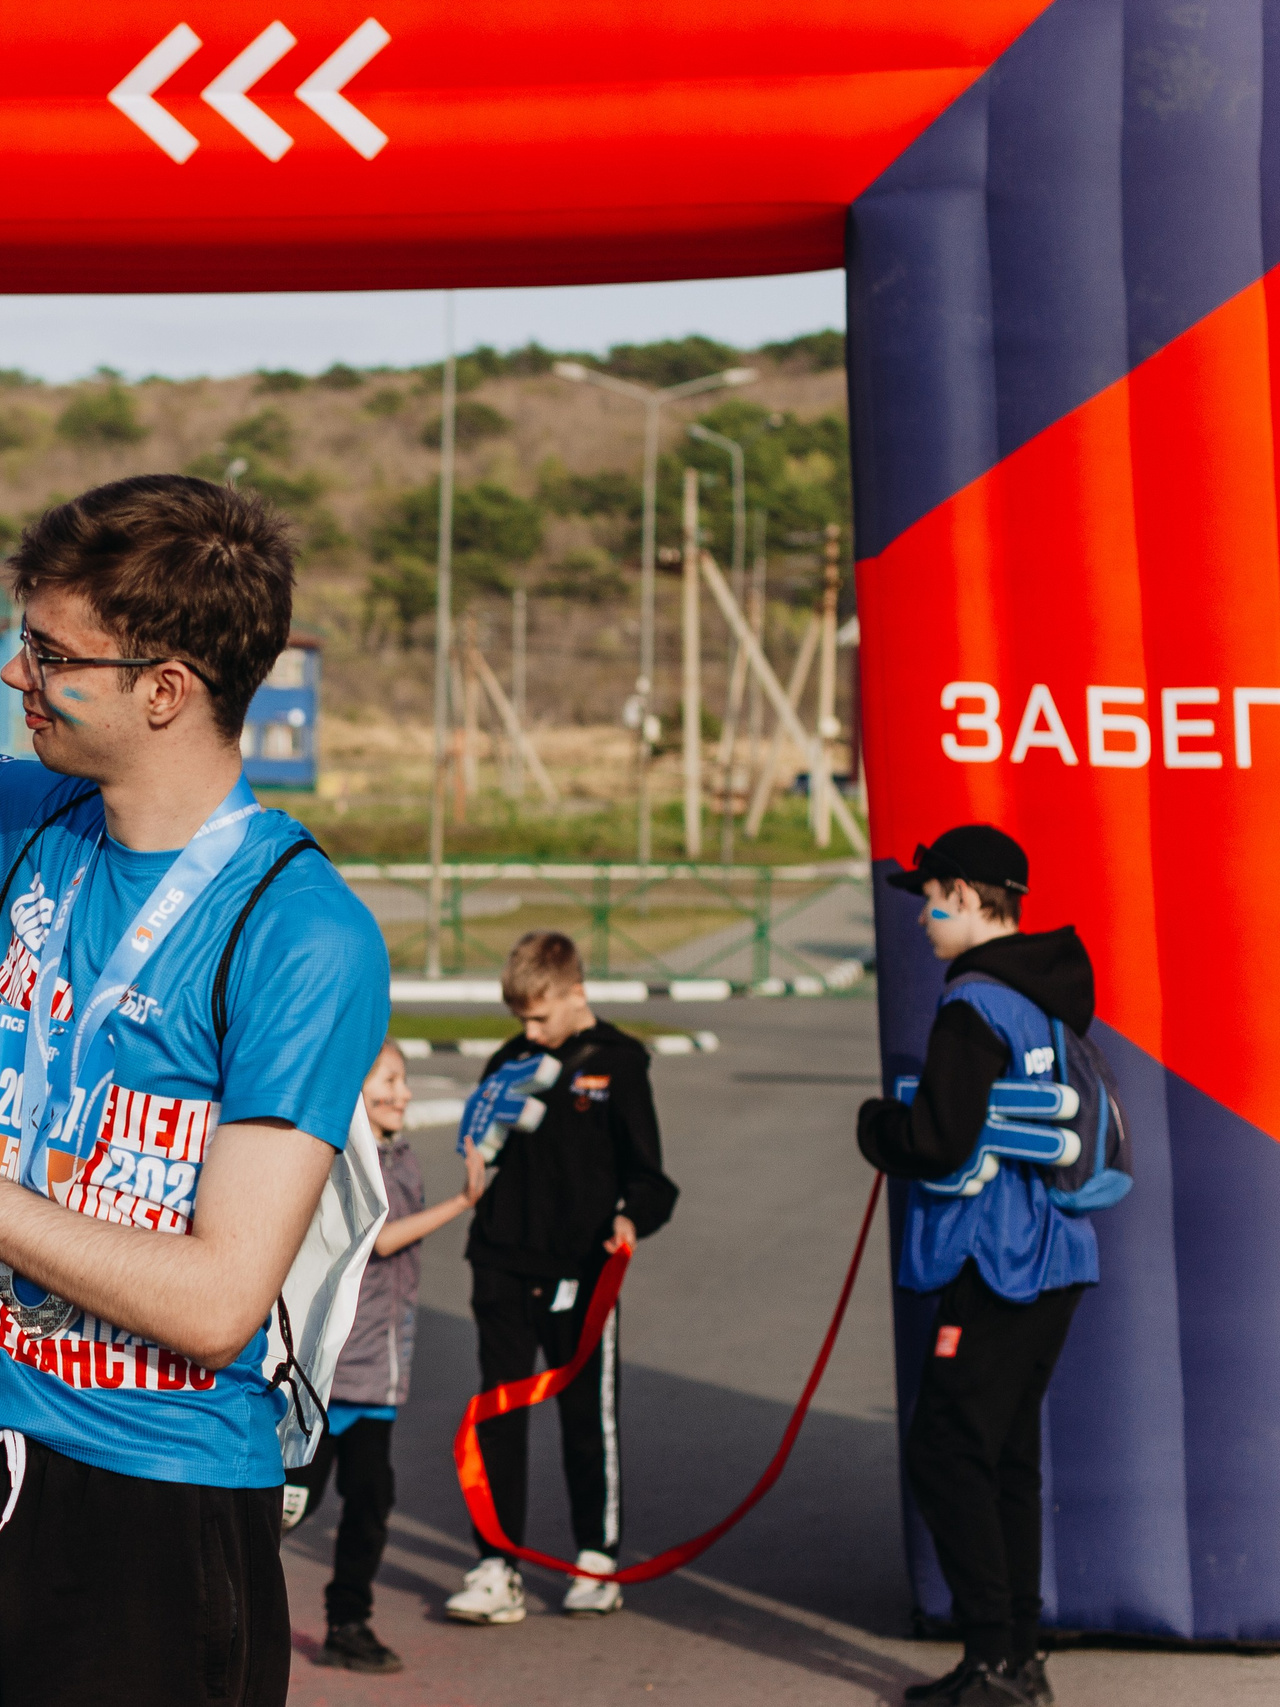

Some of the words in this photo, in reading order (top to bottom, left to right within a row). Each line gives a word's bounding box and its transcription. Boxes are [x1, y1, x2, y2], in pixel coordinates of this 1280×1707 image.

[940, 681, 1280, 769] ЗАБЕГ
[147, 887, 185, 928] ПСБ
[0, 1014, 26, 1033] ПСБ
